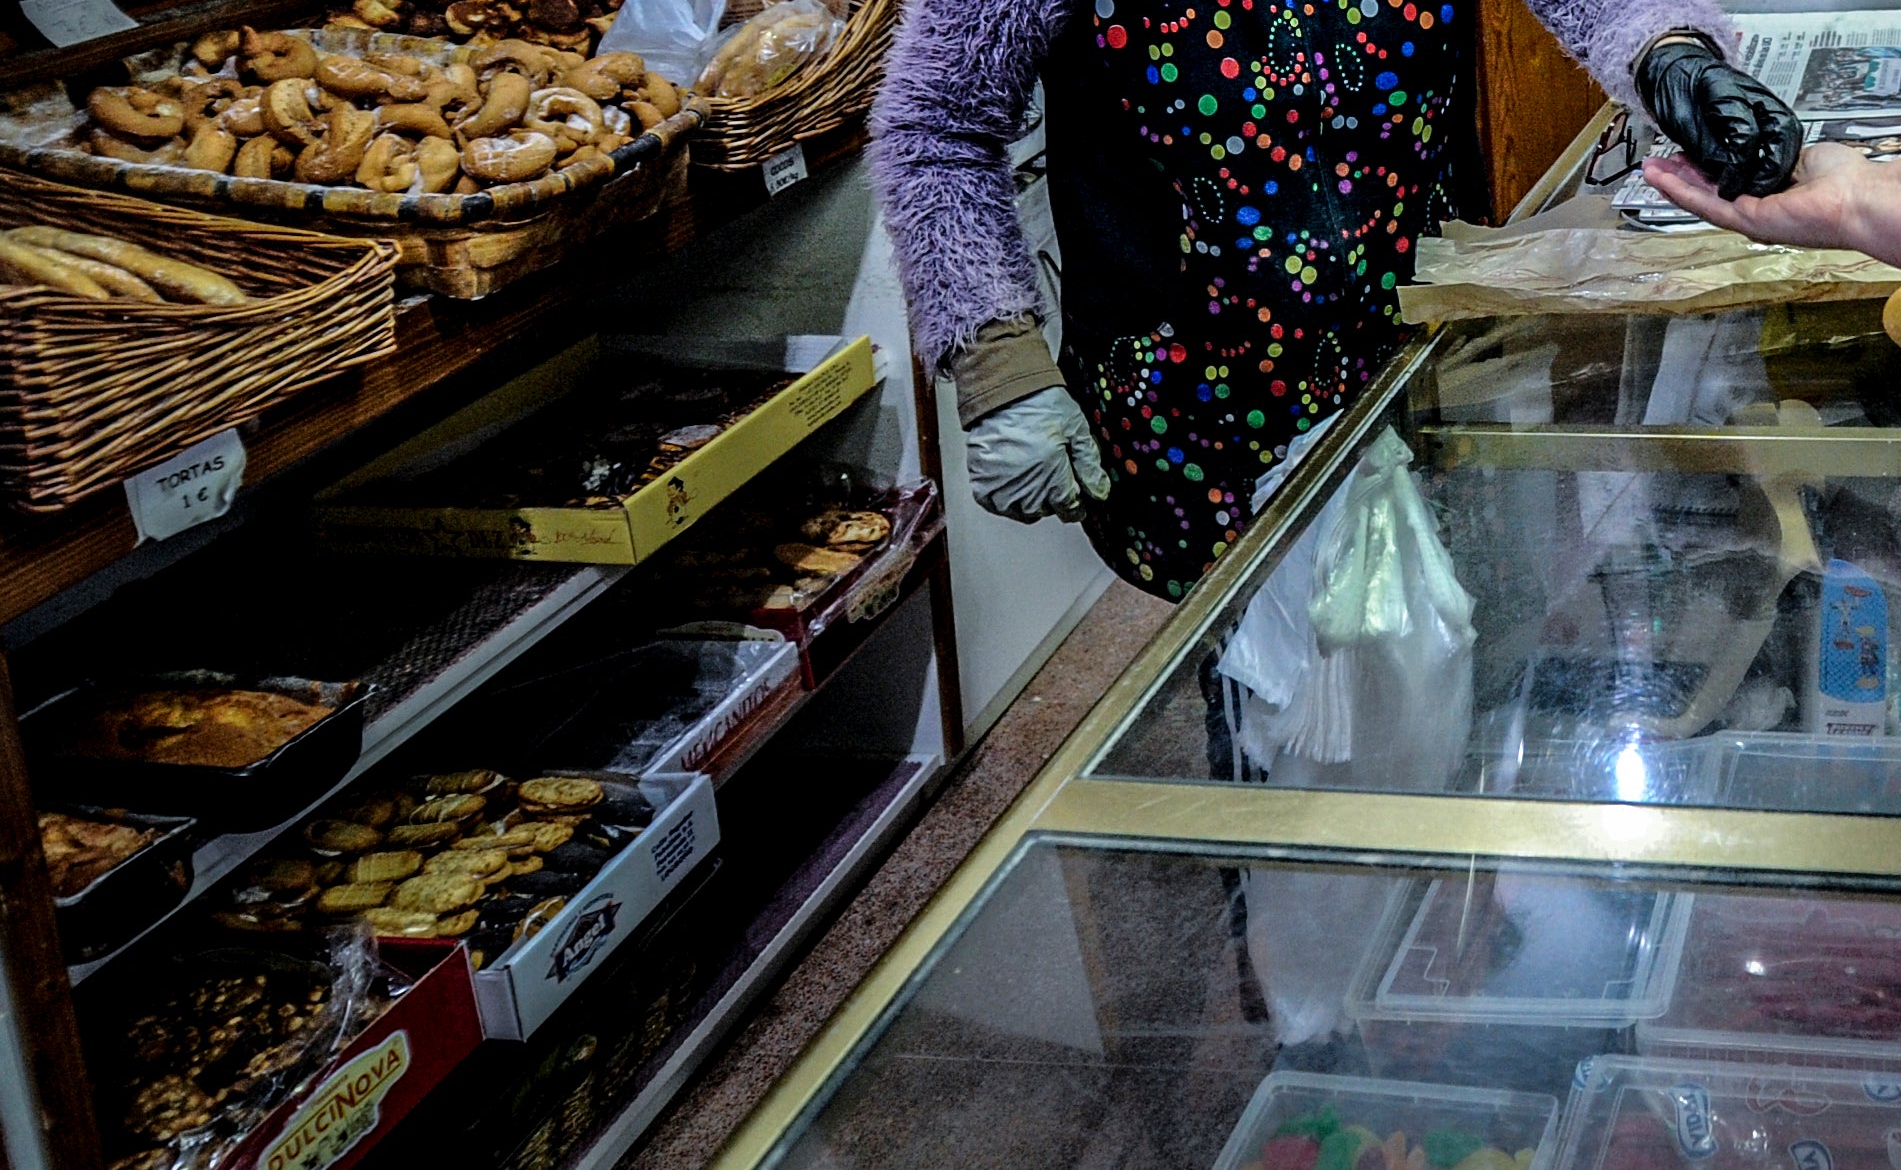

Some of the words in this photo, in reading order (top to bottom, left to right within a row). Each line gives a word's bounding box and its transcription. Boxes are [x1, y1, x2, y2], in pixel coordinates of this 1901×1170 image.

[156, 455, 226, 493] TORTAS
[183, 495, 191, 509] 1
[197, 487, 209, 503] €
[561, 912, 606, 968] Angel
[268, 1048, 400, 1170] DULCINOVA
